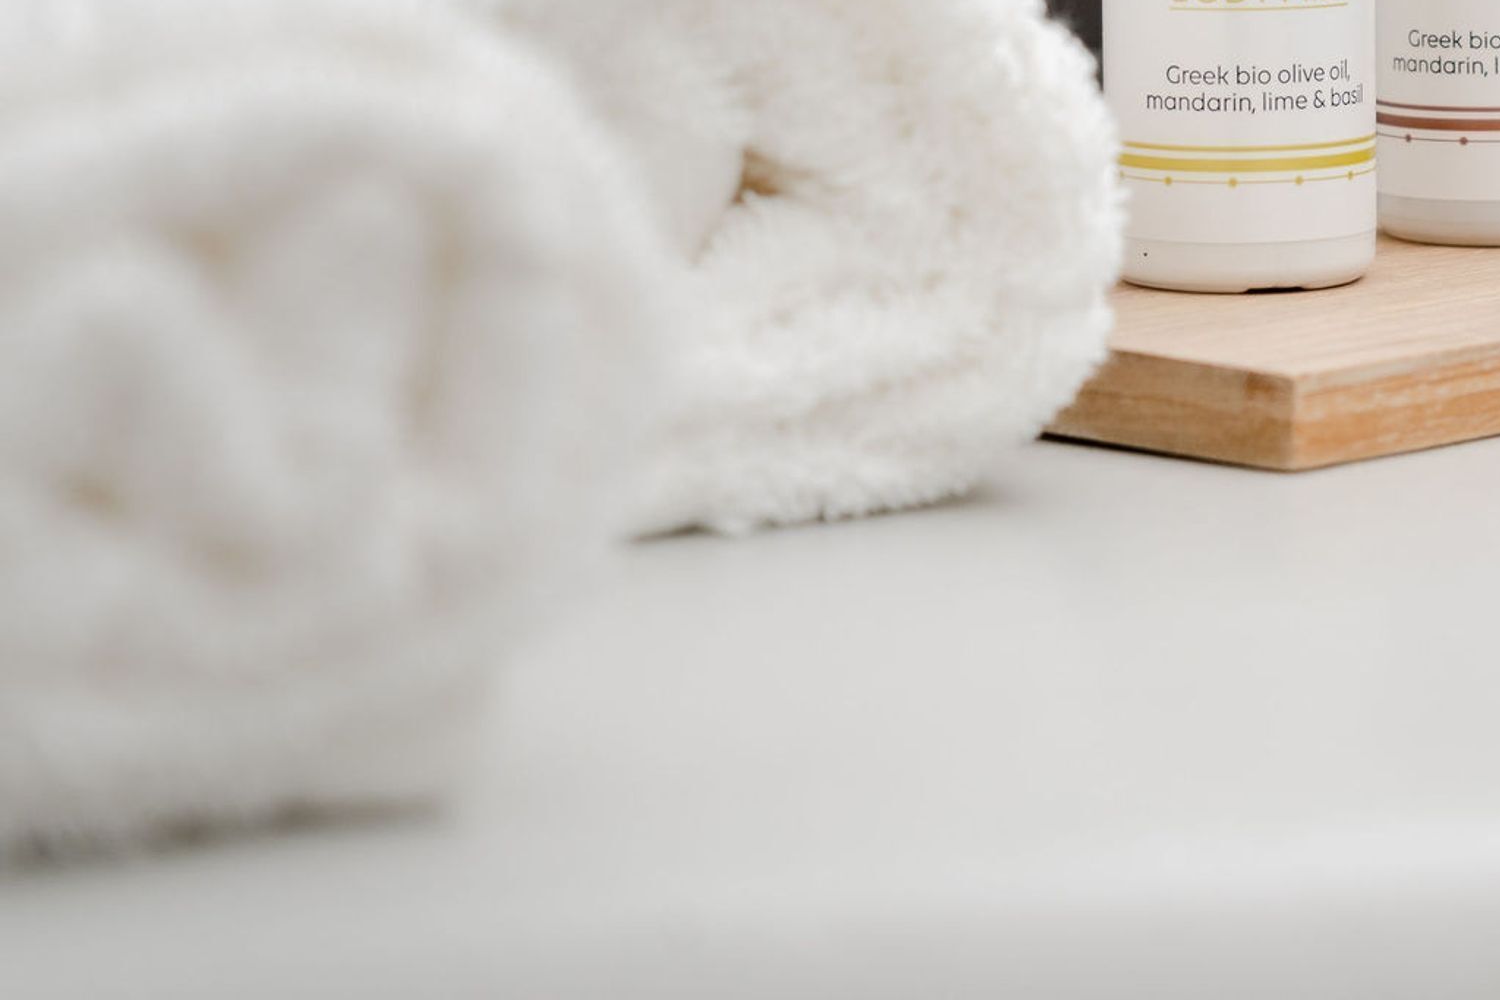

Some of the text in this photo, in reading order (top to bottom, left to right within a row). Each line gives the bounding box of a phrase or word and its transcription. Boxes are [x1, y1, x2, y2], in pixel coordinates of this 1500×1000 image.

[1408, 29, 1463, 50] Greek
[1166, 58, 1350, 86] Greek bio olive oil,
[1392, 56, 1488, 77] mandarin,
[1146, 83, 1364, 114] mandarin, lime & basil
